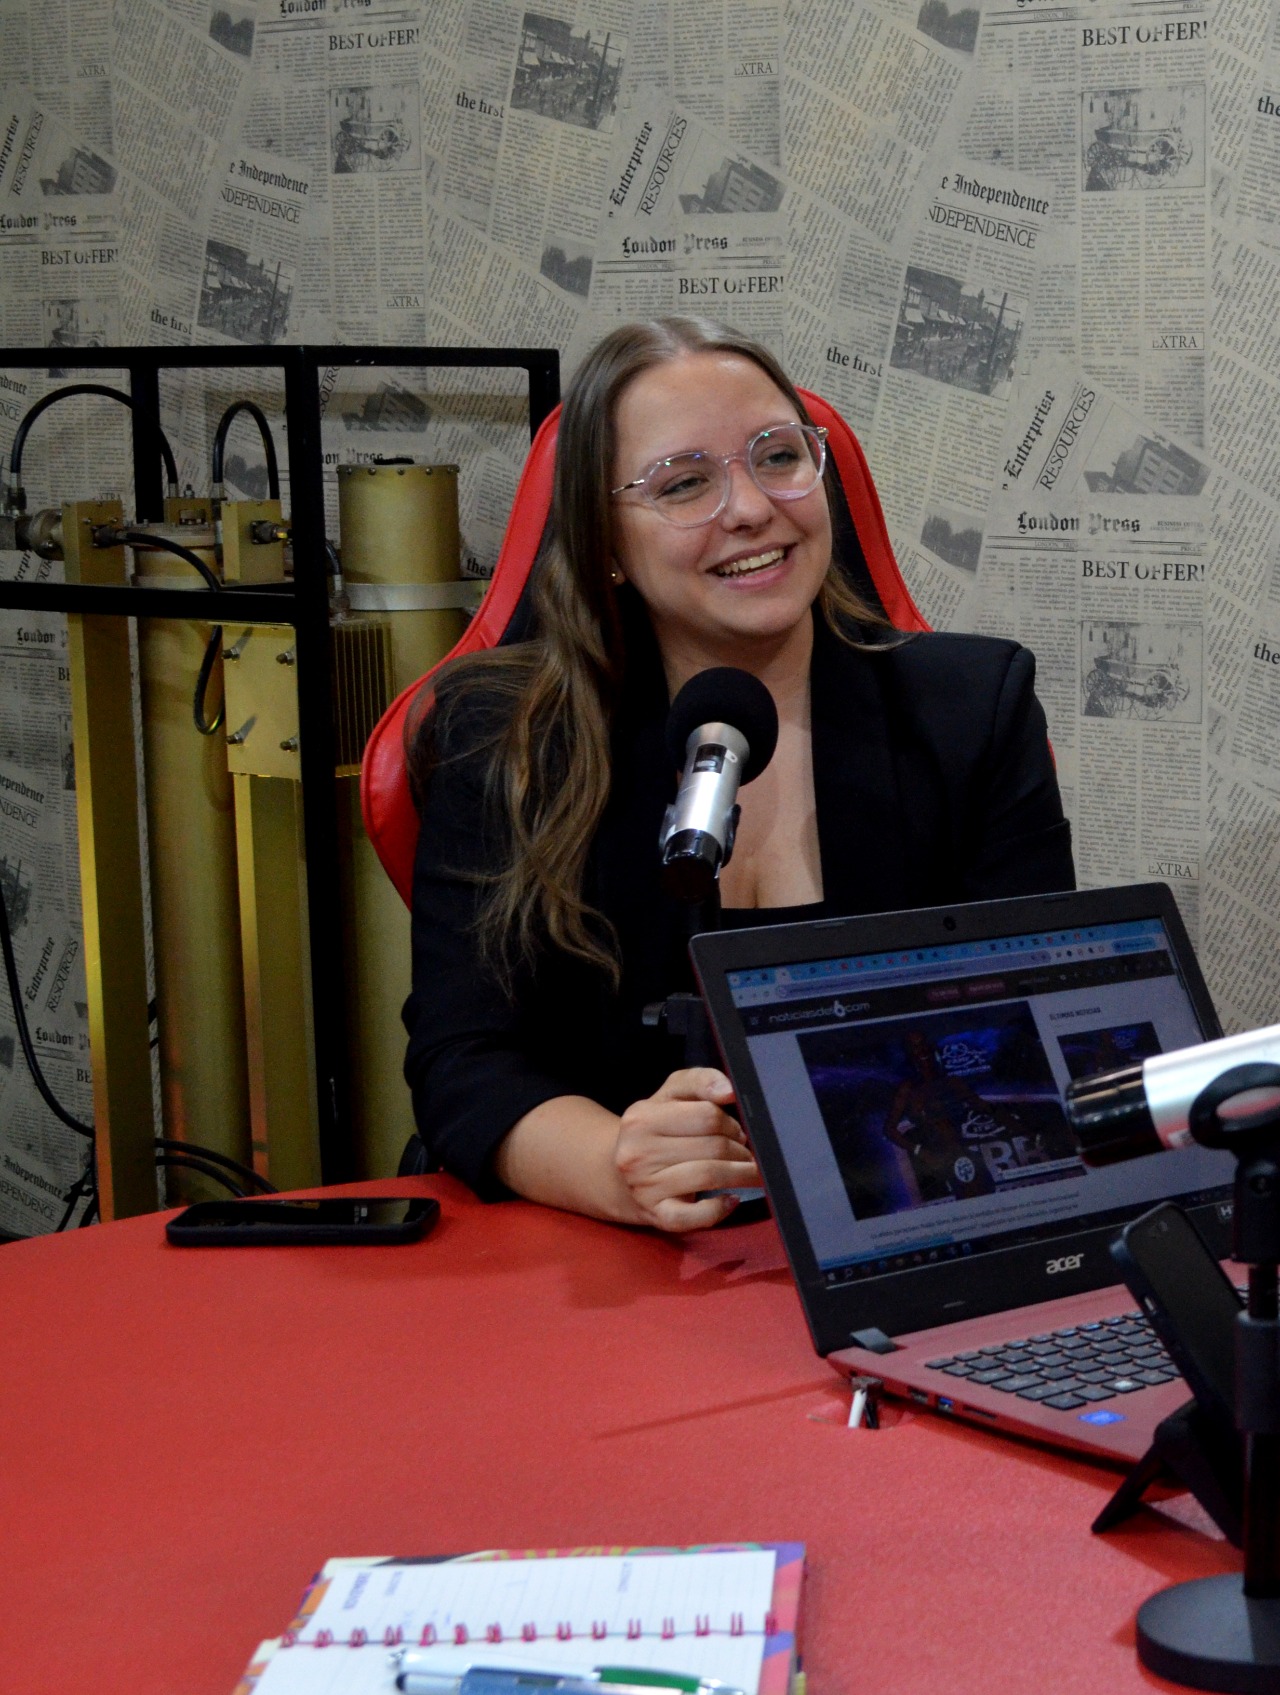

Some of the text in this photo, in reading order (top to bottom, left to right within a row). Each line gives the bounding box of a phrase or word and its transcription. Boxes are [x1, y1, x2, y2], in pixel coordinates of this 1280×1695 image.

[329, 28, 420, 50] BEST OFFER!
[1082, 20, 1208, 46] BEST OFFER!
[456, 91, 504, 119] the first
[239, 159, 309, 195] Independence
[609, 121, 653, 208] Enterprise
[640, 116, 688, 216] RESOURCES
[954, 172, 1050, 216] Independence
[42, 248, 119, 265] BEST OFFER!
[622, 235, 676, 258] London
[684, 233, 728, 255] Press
[679, 275, 784, 294] BEST OFFER!
[151, 308, 193, 336] the first
[826, 346, 883, 378] the first
[1003, 388, 1056, 480] Enterprise
[1040, 386, 1096, 491] RESOURCES
[1016, 510, 1141, 535] London Press
[466, 558, 487, 575] the
[1081, 558, 1206, 582] BEST OFFER!
[1253, 641, 1280, 666] the
[1046, 1253, 1084, 1275] acer
